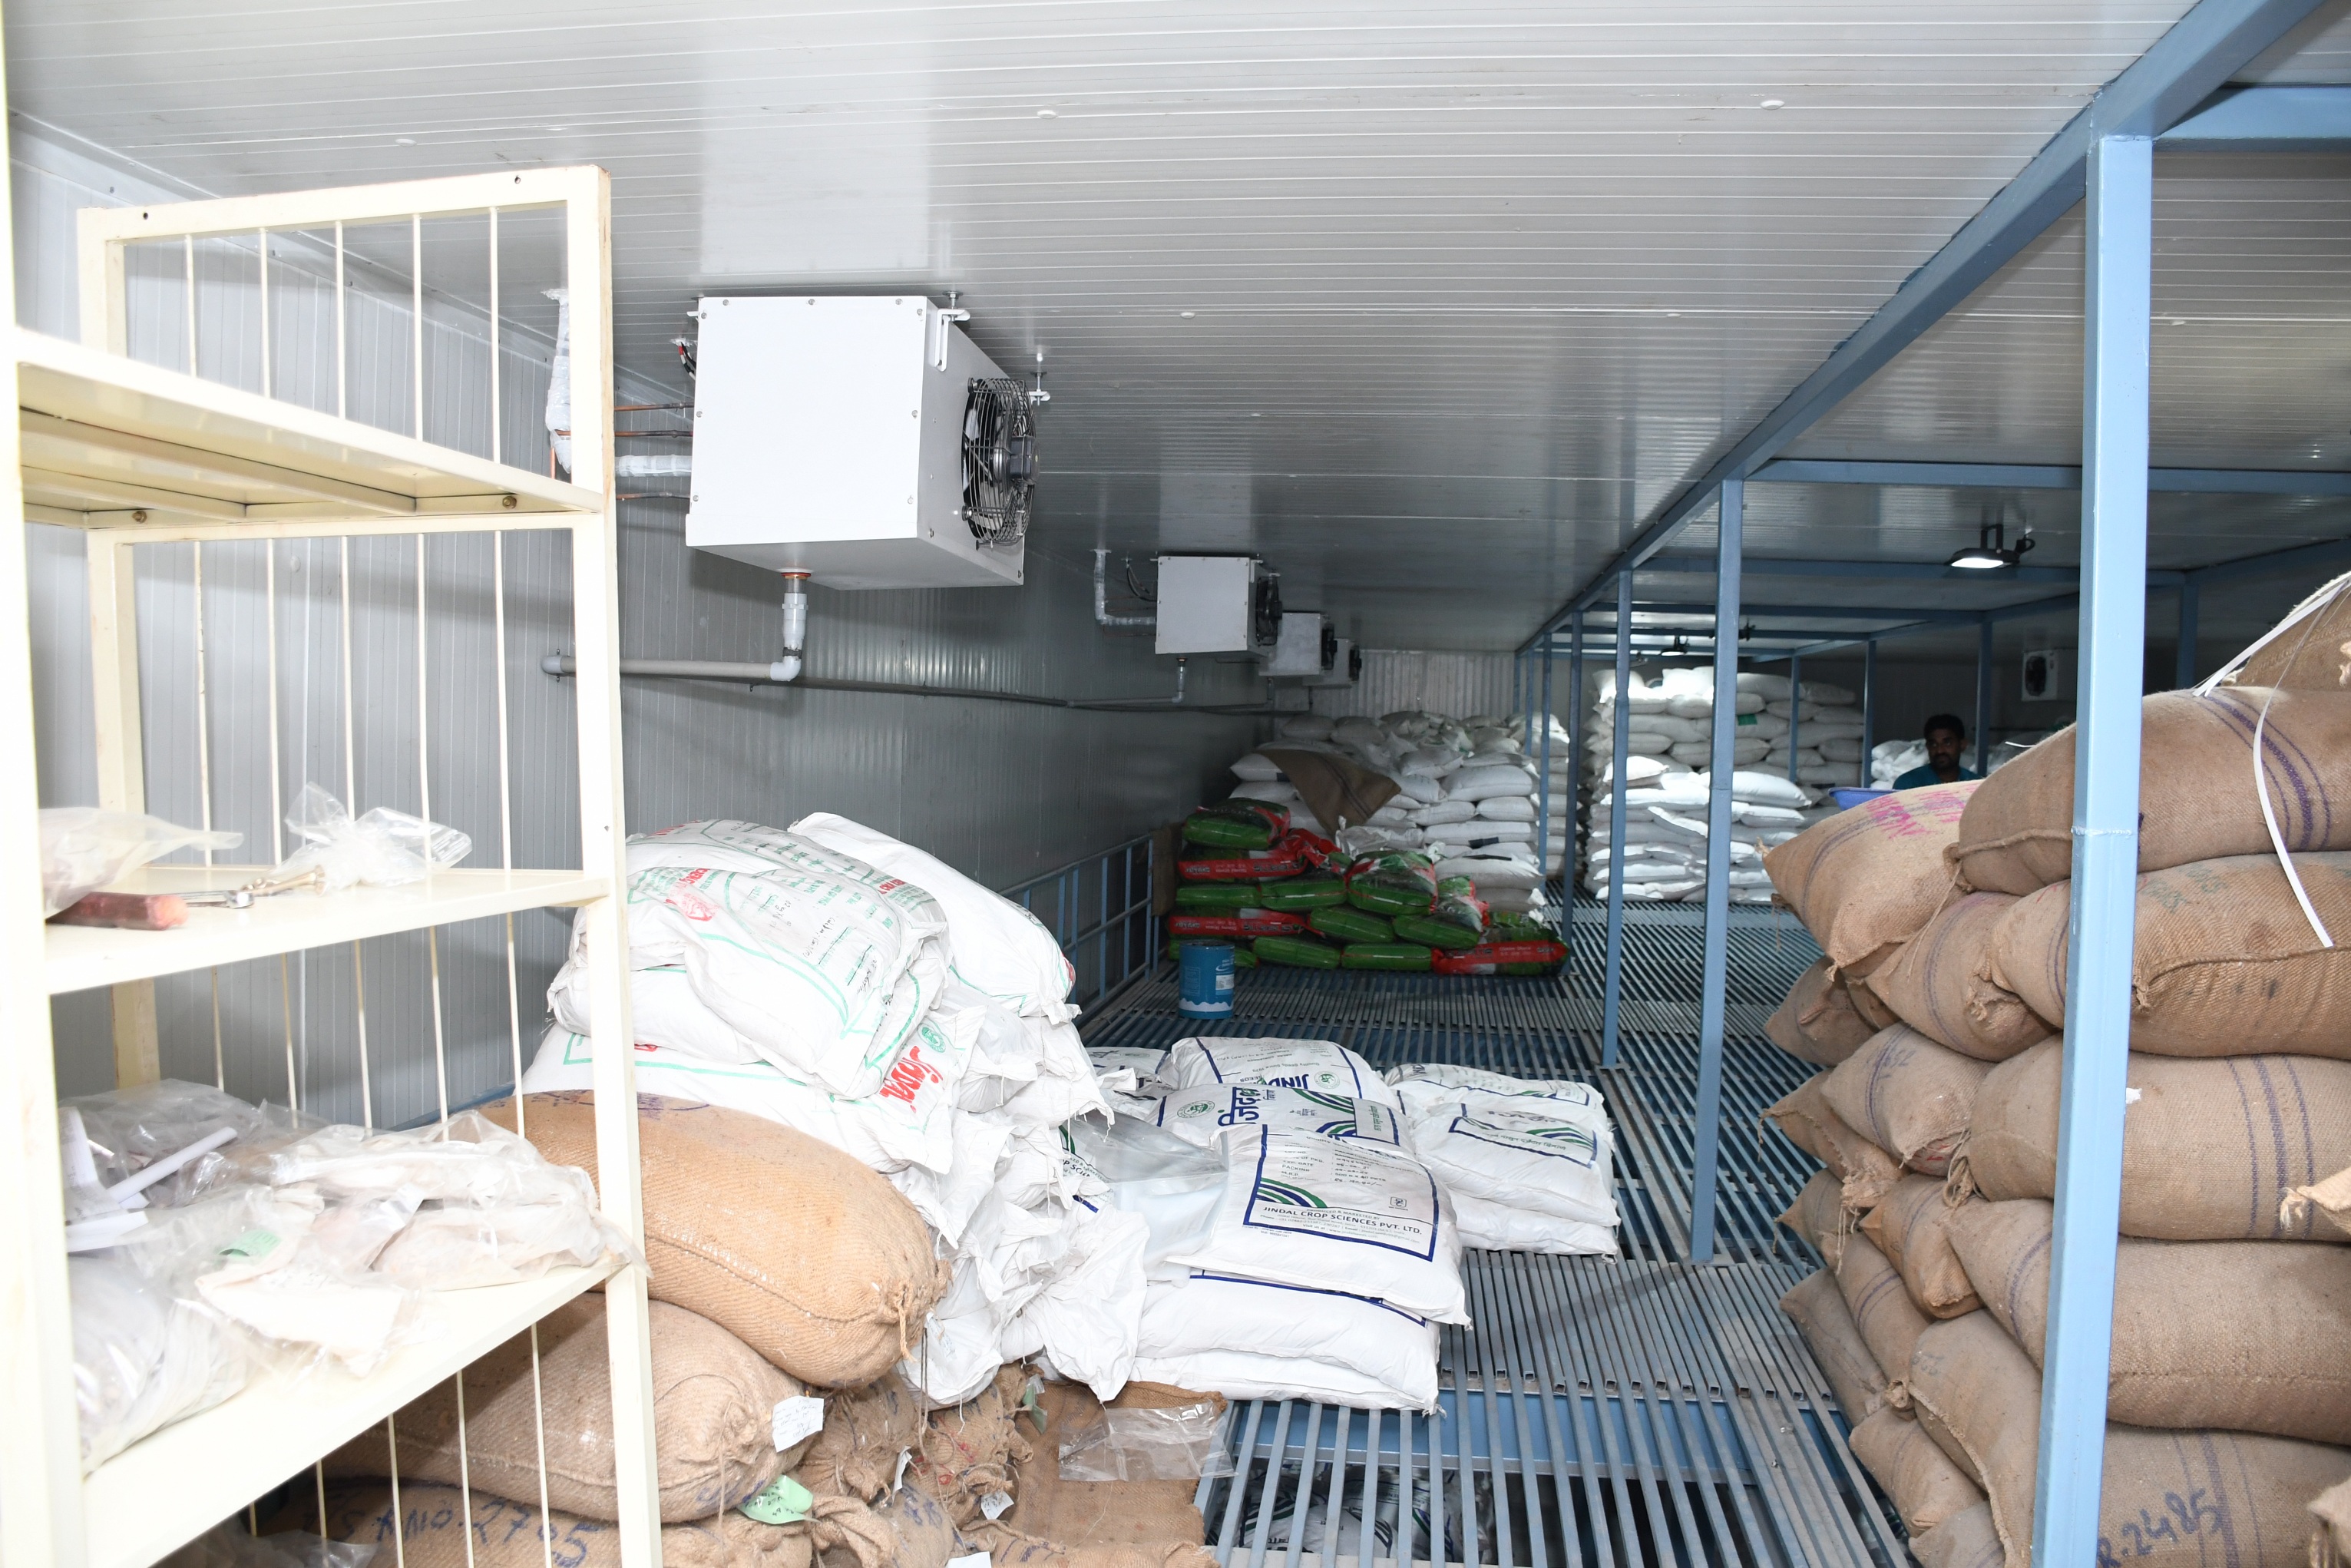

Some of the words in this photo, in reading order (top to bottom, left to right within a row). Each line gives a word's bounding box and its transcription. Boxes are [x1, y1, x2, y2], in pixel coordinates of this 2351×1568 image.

[1263, 1206, 1298, 1216] JINDAL
[1300, 1210, 1328, 1219] CROP
[1331, 1214, 1378, 1226] SCIENCES
[1380, 1222, 1401, 1232] PVT.
[1403, 1226, 1423, 1235] LTD.
